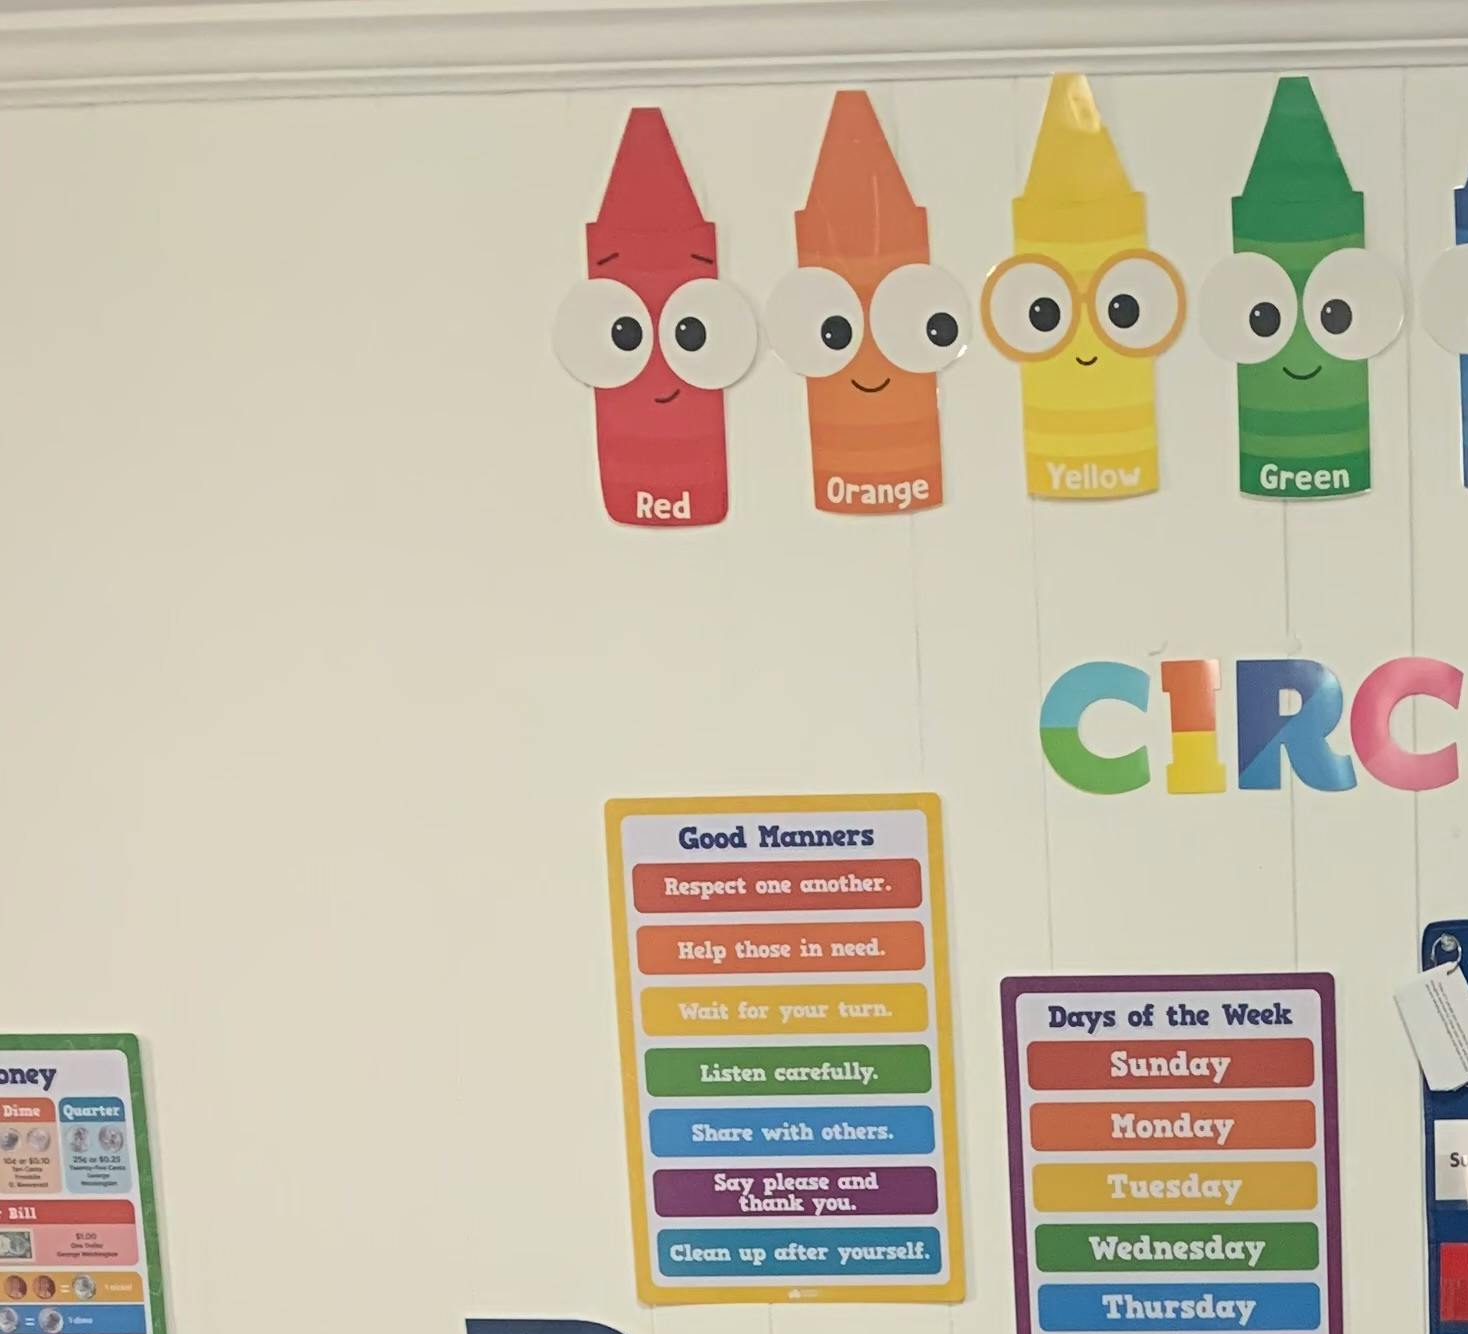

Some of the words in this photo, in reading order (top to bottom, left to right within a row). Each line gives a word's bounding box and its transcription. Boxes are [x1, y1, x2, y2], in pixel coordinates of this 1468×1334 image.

[1046, 462, 1141, 491] Yellow
[1259, 463, 1349, 491] Green
[635, 491, 691, 520] Red
[826, 477, 930, 511] Orange
[679, 826, 747, 850] Good
[759, 823, 875, 847] Manners
[665, 877, 746, 900] Respect
[756, 879, 791, 894] one
[800, 876, 893, 894] another.
[1048, 1006, 1115, 1034] Days
[1127, 1004, 1154, 1027] of
[1166, 1004, 1209, 1026] the
[1222, 1003, 1293, 1025] Week
[700, 1064, 766, 1082] Listen
[774, 1063, 879, 1084] carefully.
[1110, 1051, 1231, 1084] Sunday
[63, 1104, 120, 1120] Quarter
[1110, 1113, 1235, 1145] Monday
[1107, 1173, 1242, 1206] Tuesday
[1088, 1235, 1265, 1267] Wednesday
[1102, 1294, 1256, 1326] Thursday
